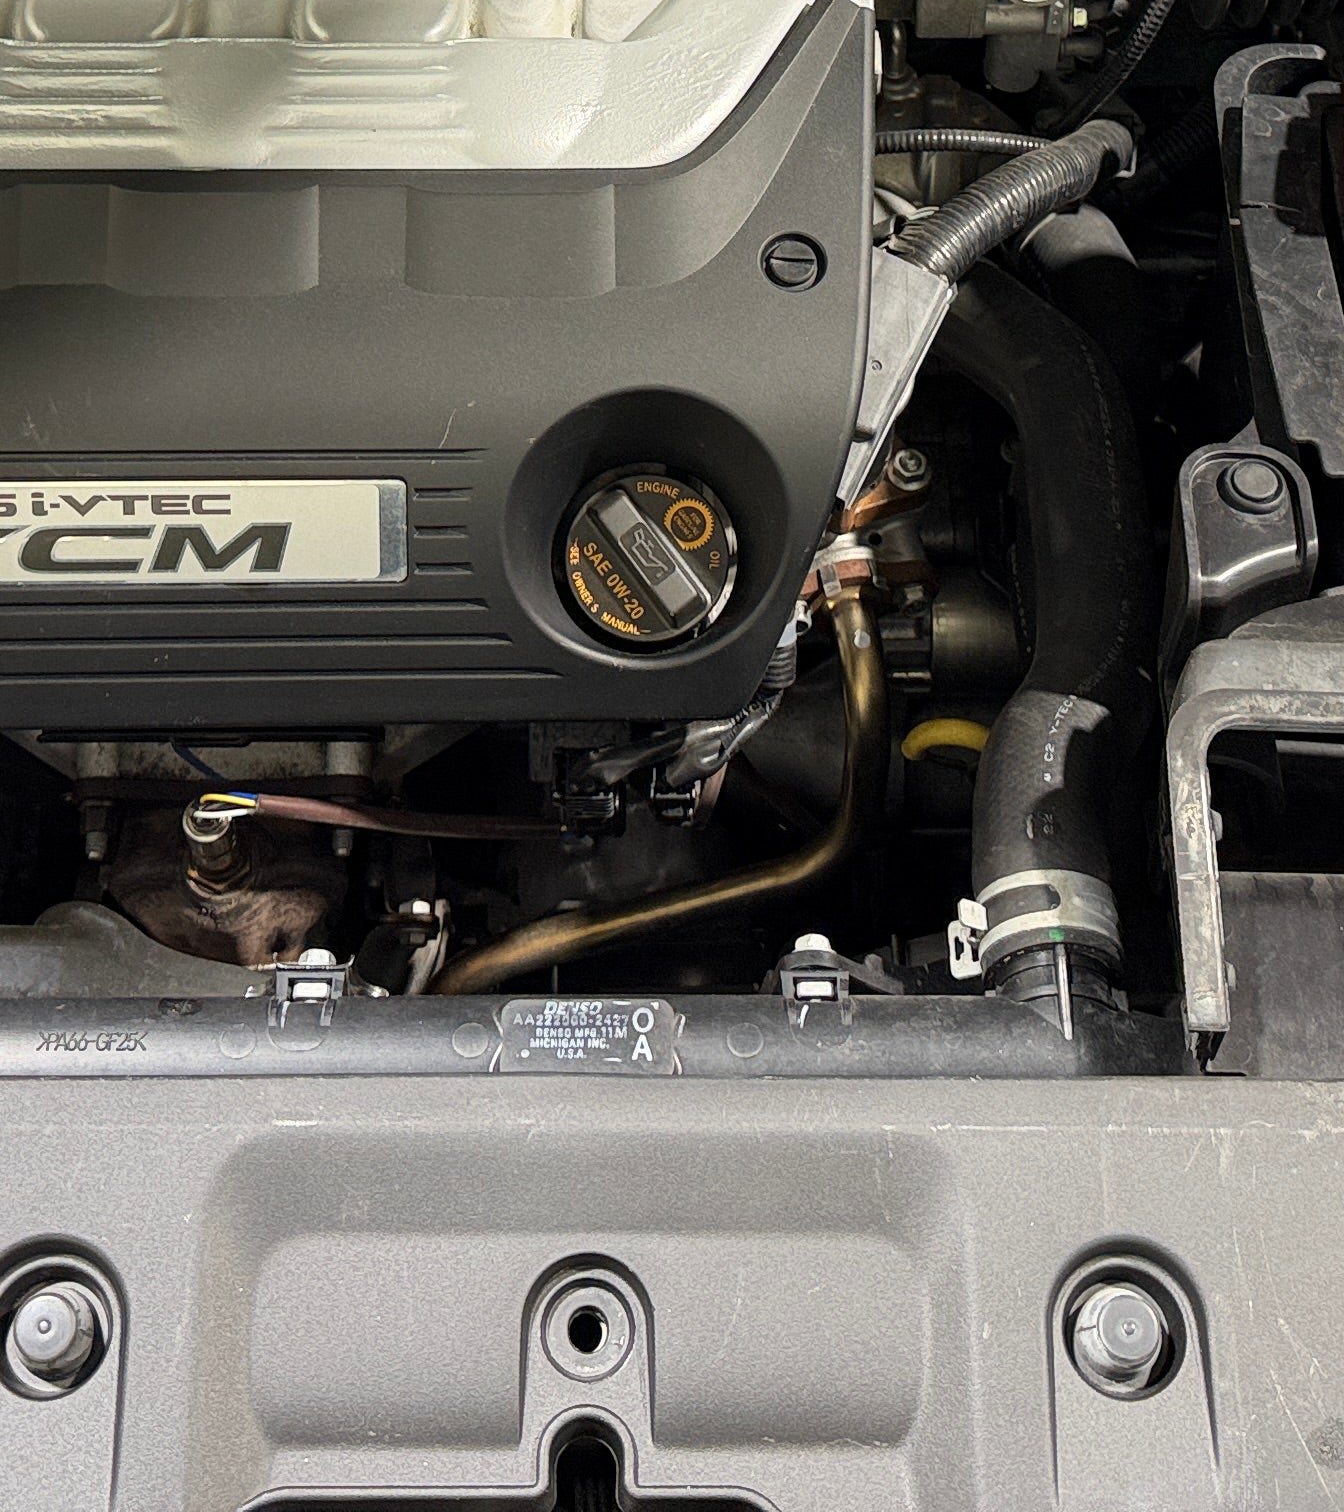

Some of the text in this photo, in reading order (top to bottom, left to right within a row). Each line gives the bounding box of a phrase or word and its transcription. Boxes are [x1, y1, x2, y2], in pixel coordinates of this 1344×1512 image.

[636, 481, 680, 499] ENGINE
[31, 491, 232, 517] i-VTEC
[709, 550, 721, 570] OIL
[583, 542, 645, 621] SAE 0W-20
[572, 571, 600, 614] OWNER'S
[543, 1001, 603, 1015] DENSO
[535, 1027, 572, 1038] DENSO
[530, 1038, 610, 1049] MICHIGAN INC.
[632, 1034, 653, 1062] A
